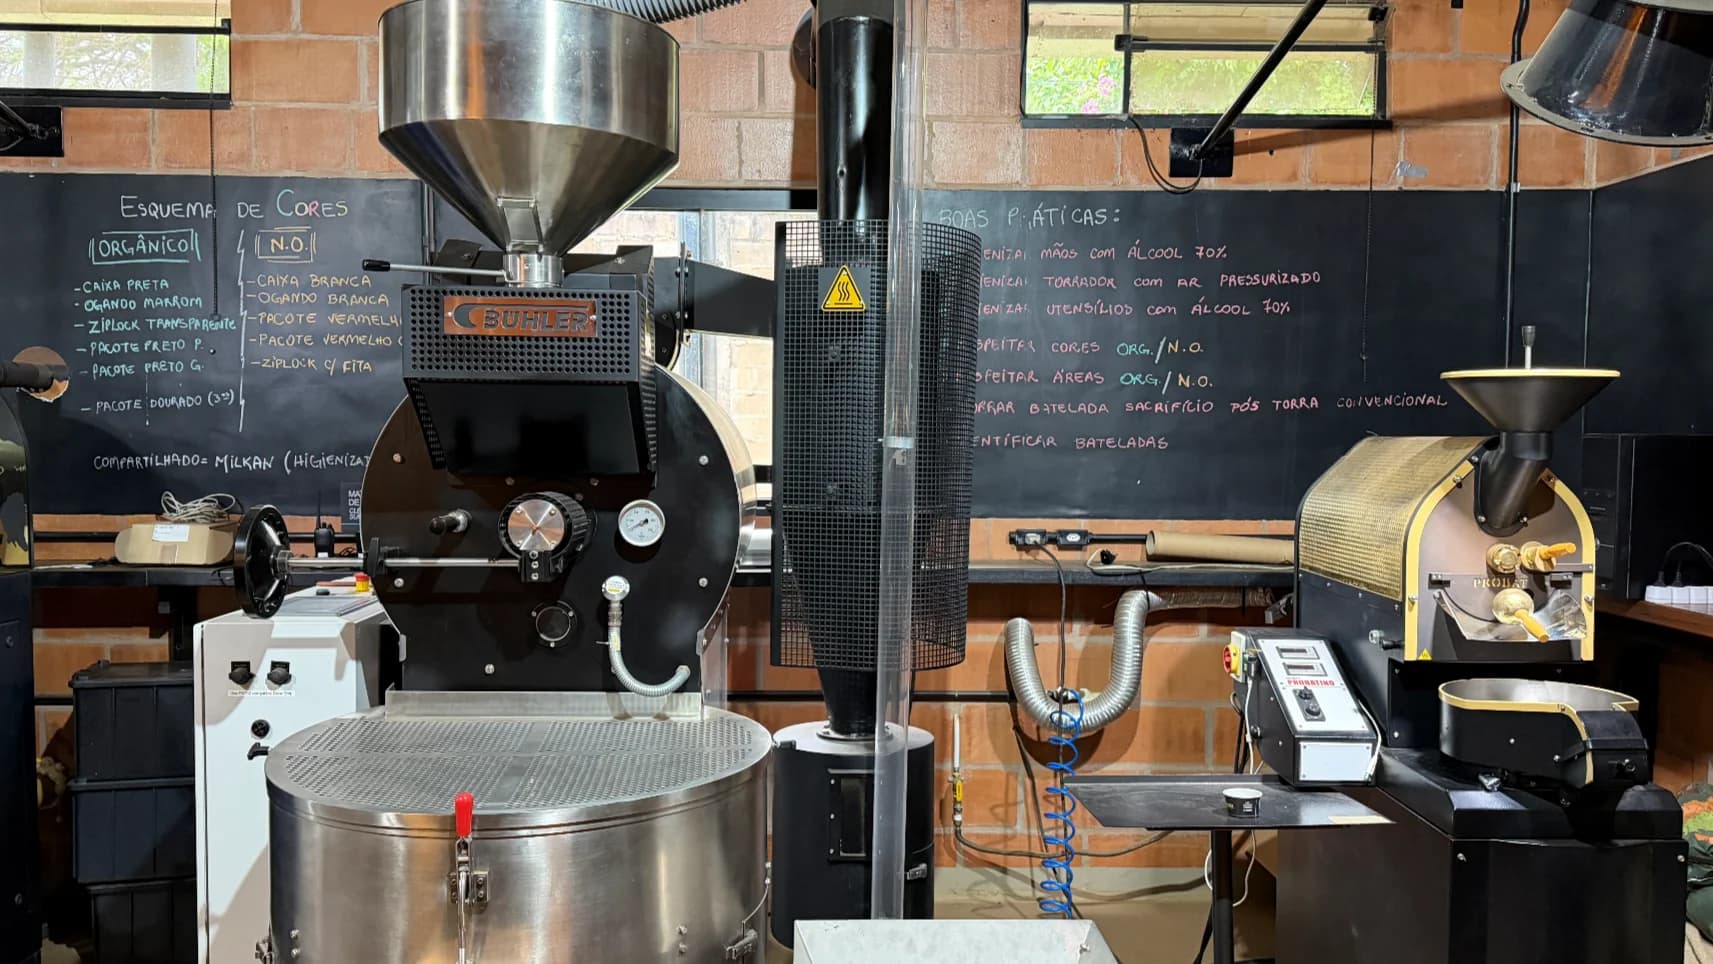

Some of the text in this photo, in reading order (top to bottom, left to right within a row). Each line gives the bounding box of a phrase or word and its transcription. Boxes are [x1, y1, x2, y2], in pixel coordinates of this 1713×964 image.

[120, 188, 348, 219] ESQUEMA DE CORES
[940, 201, 1121, 230] BOAS PÁTICAS:
[98, 233, 189, 257] ORGÂNICO
[270, 235, 308, 253] N.O.
[1040, 242, 1078, 259] MÃOS
[1127, 239, 1183, 260] ÁLCOOL
[1195, 245, 1227, 260] 70%
[127, 279, 169, 291] PRETA
[309, 274, 372, 288] BRANCA
[1042, 275, 1117, 289] TORRADOR
[1177, 277, 1203, 288] AR
[1219, 270, 1321, 287] PRESSURIZADO
[84, 298, 137, 312] OGANDO
[143, 295, 202, 309] MARROM
[328, 293, 390, 307] BRANCA
[1046, 299, 1133, 316] UTENSÍLIOS
[1191, 296, 1250, 316] ÁLCOOL
[1262, 298, 1290, 315] 70%
[328, 312, 402, 327] VERMELH
[144, 338, 185, 353] PRETO
[323, 334, 392, 347] VERMELHO
[1051, 341, 1100, 354] CORES
[144, 360, 184, 374] PRETO
[342, 360, 372, 374] FITA
[1053, 368, 1104, 385] ÁREAS
[150, 395, 202, 410] DOURADO
[1230, 396, 1260, 413] PÓS
[1272, 396, 1319, 411] TORRA
[1074, 436, 1169, 450] BATELADAS
[214, 453, 274, 474] MILKAN
